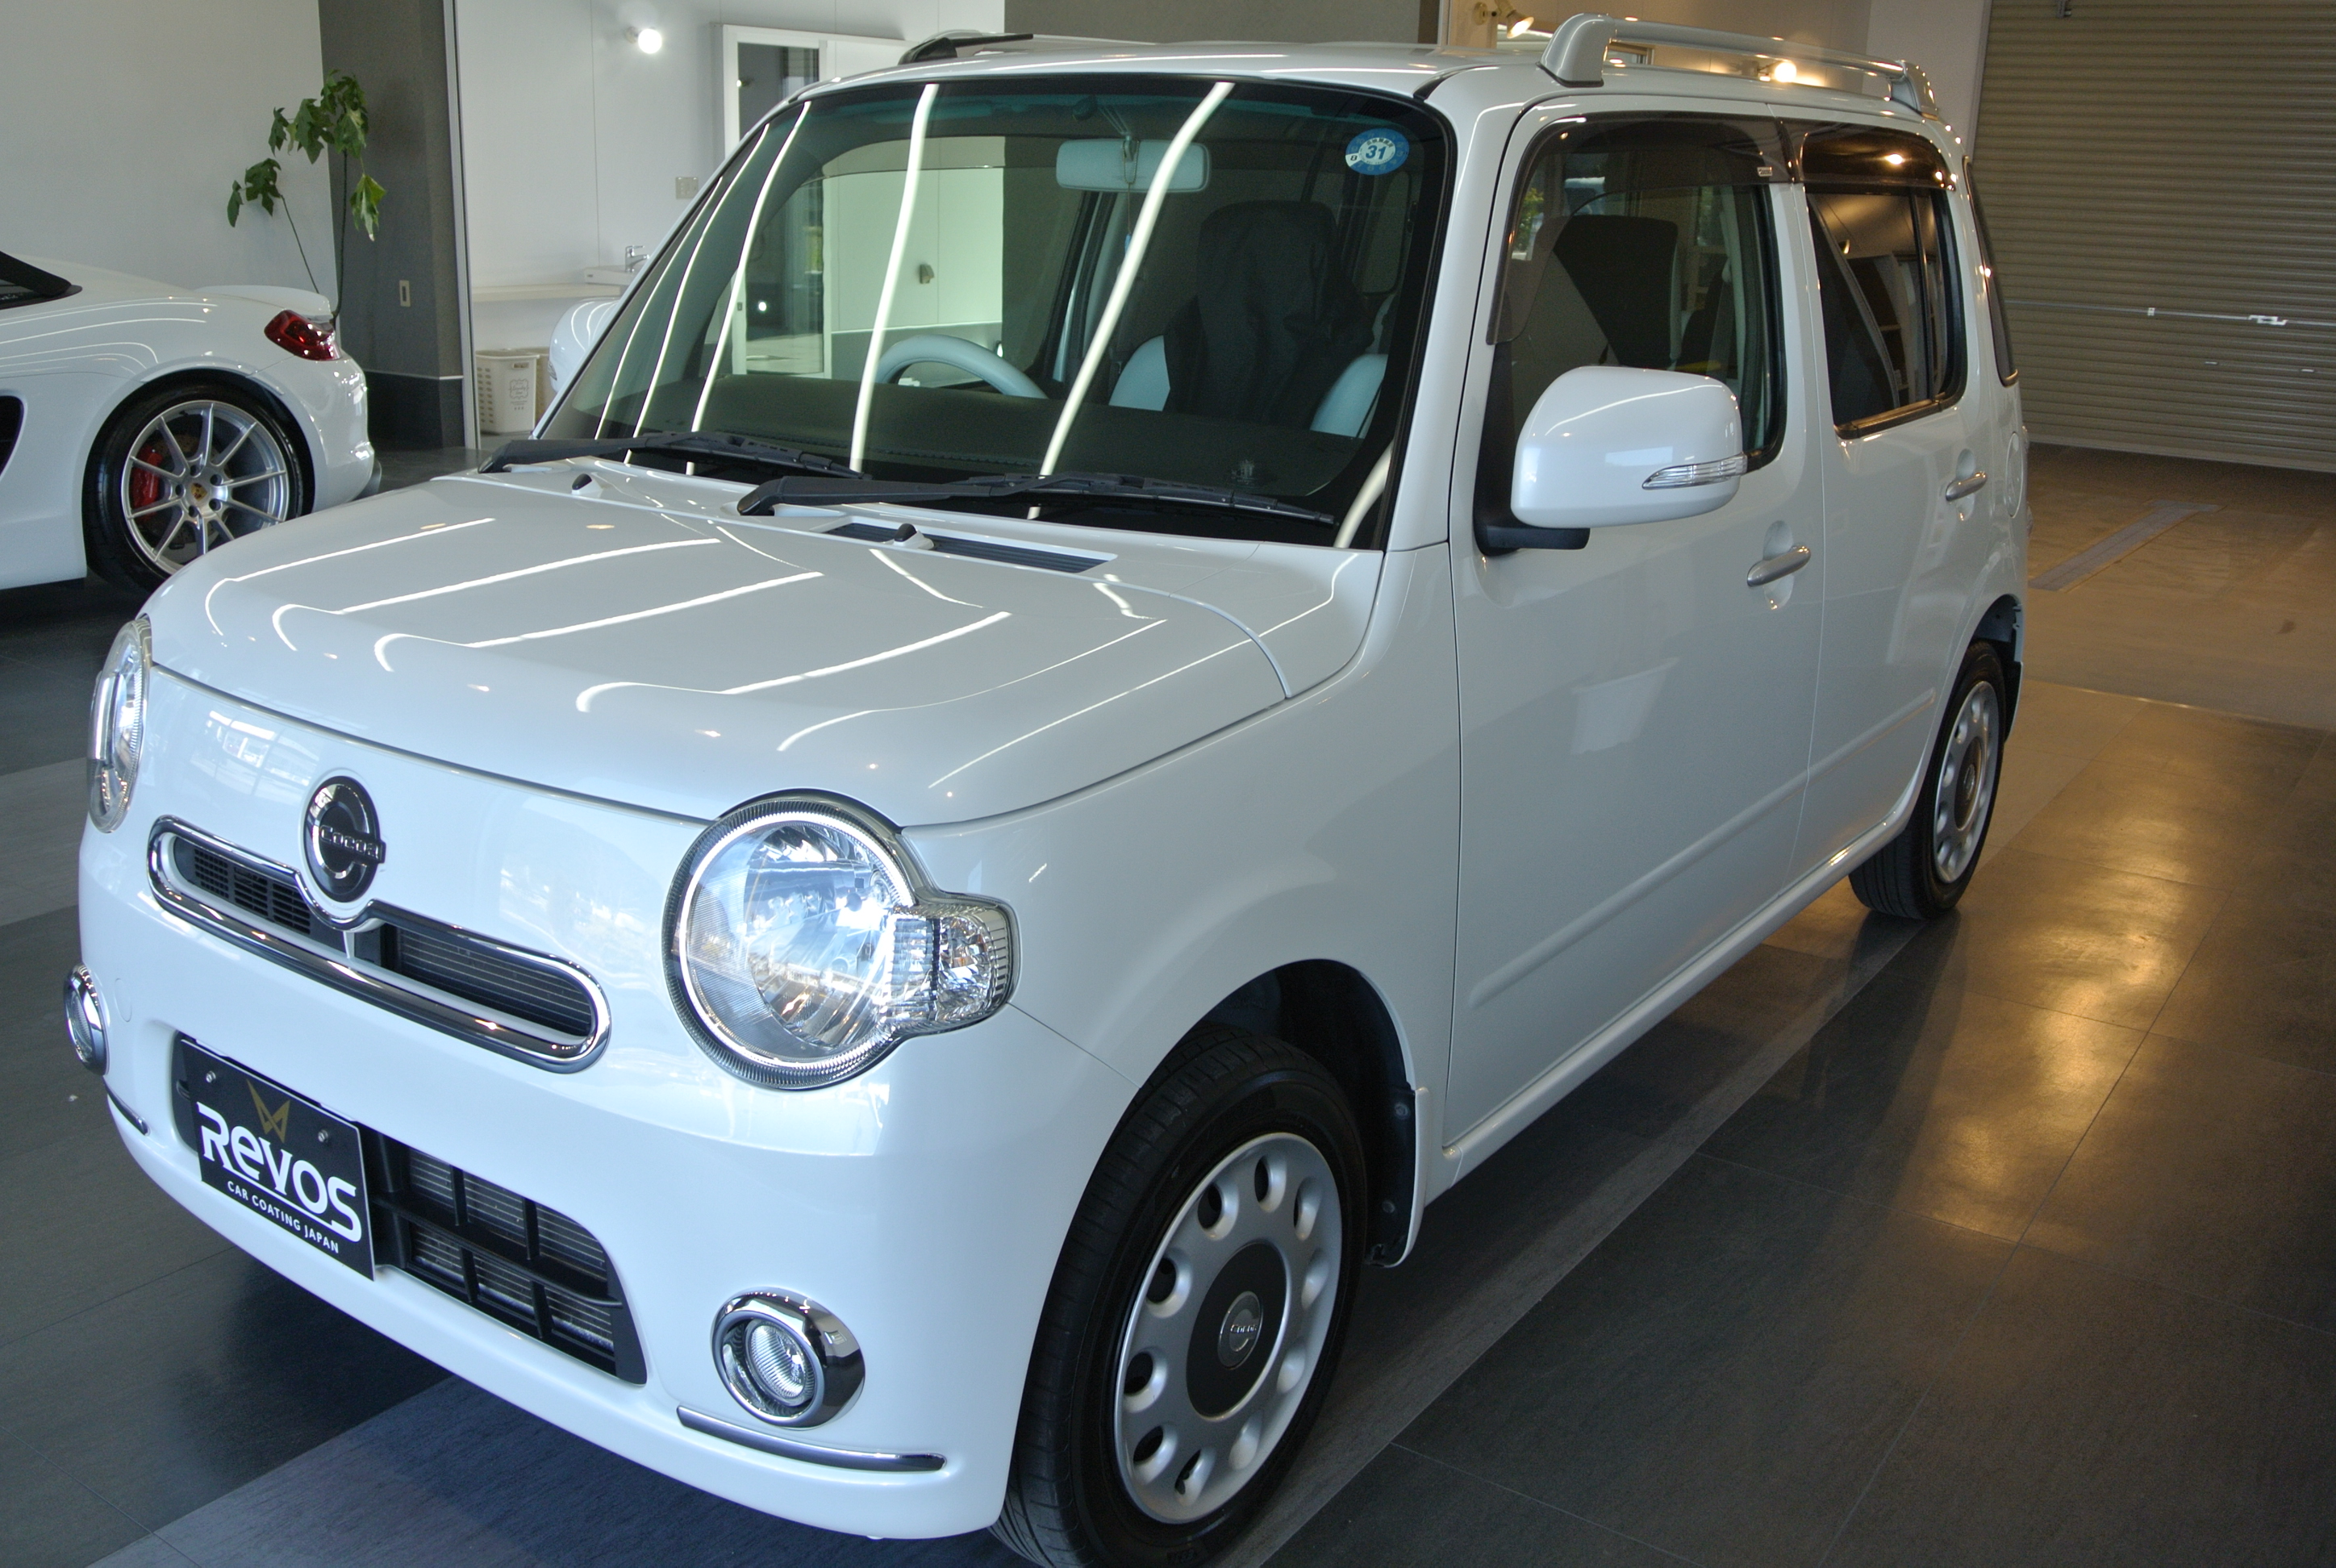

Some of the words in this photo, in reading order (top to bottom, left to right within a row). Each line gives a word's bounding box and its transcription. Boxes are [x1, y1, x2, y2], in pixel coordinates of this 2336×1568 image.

[1366, 144, 1387, 160] 31
[227, 1181, 248, 1201] CAR
[252, 1195, 301, 1231] COATING
[304, 1224, 339, 1253] JAPAN
